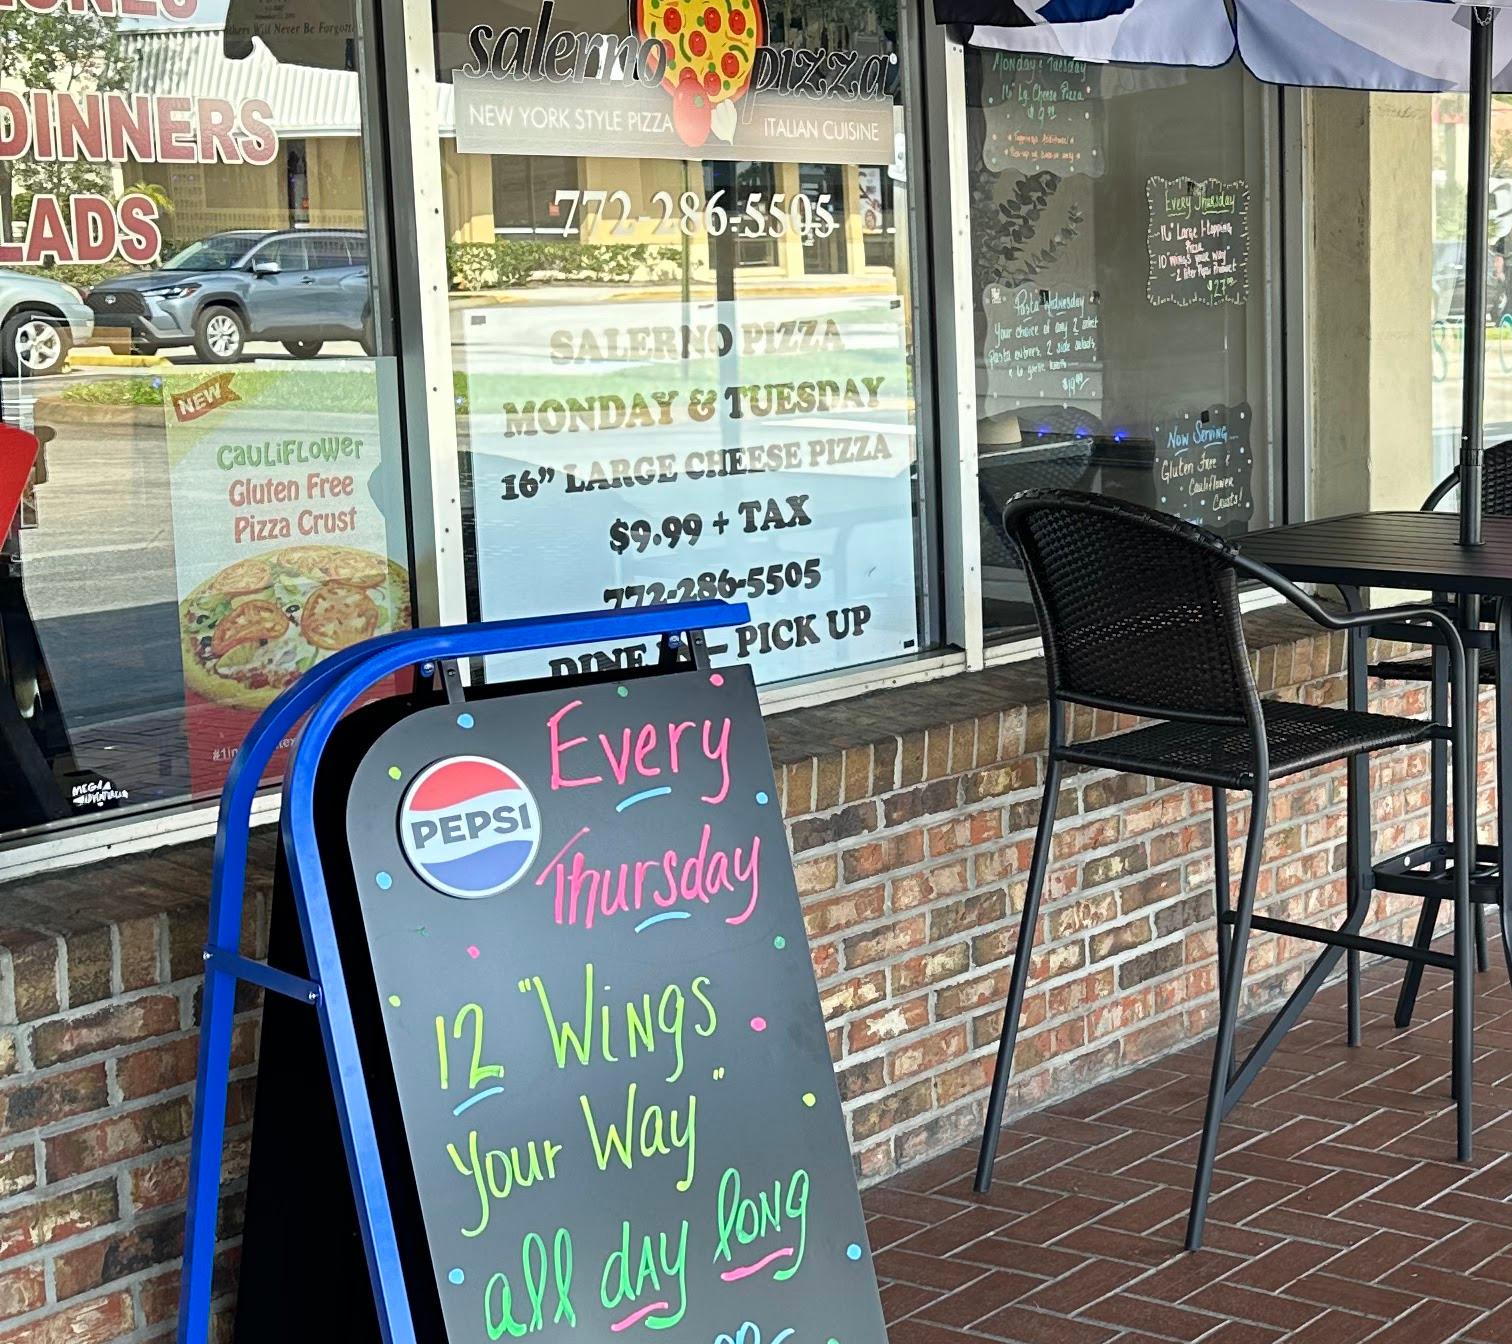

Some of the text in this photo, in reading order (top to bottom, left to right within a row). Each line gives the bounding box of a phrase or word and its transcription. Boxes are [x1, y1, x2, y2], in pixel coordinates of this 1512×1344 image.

[273, 23, 300, 34] Never
[304, 22, 315, 34] Be
[463, 0, 896, 125] salerno pizza
[1046, 57, 1087, 82] Tuesday
[0, 89, 280, 166] DINNERS
[469, 104, 880, 142] NEW YORK STYLE PIZZA ITALIAN CUISINE
[553, 189, 836, 239] 772-286-5505
[1165, 190, 1191, 219] Every
[550, 317, 846, 365] SALERNO PIZZA
[178, 383, 223, 415] NEW
[503, 375, 886, 438] MONDAY & TUESDAY
[564, 454, 678, 494] LARGE
[684, 442, 802, 480] CHEESE
[809, 434, 892, 465] PIZZA
[1161, 457, 1193, 485] Gluten
[228, 472, 354, 508] Gluten Free
[233, 506, 358, 544] Pizza Crust
[609, 494, 812, 556] $9.99 + TAX
[735, 615, 821, 659] PICK
[827, 604, 872, 641] UP
[546, 699, 731, 805] Every
[411, 802, 532, 850] PEPSI
[535, 824, 761, 929] Thursday
[435, 1002, 505, 1090] 12
[484, 1227, 577, 1340] all
